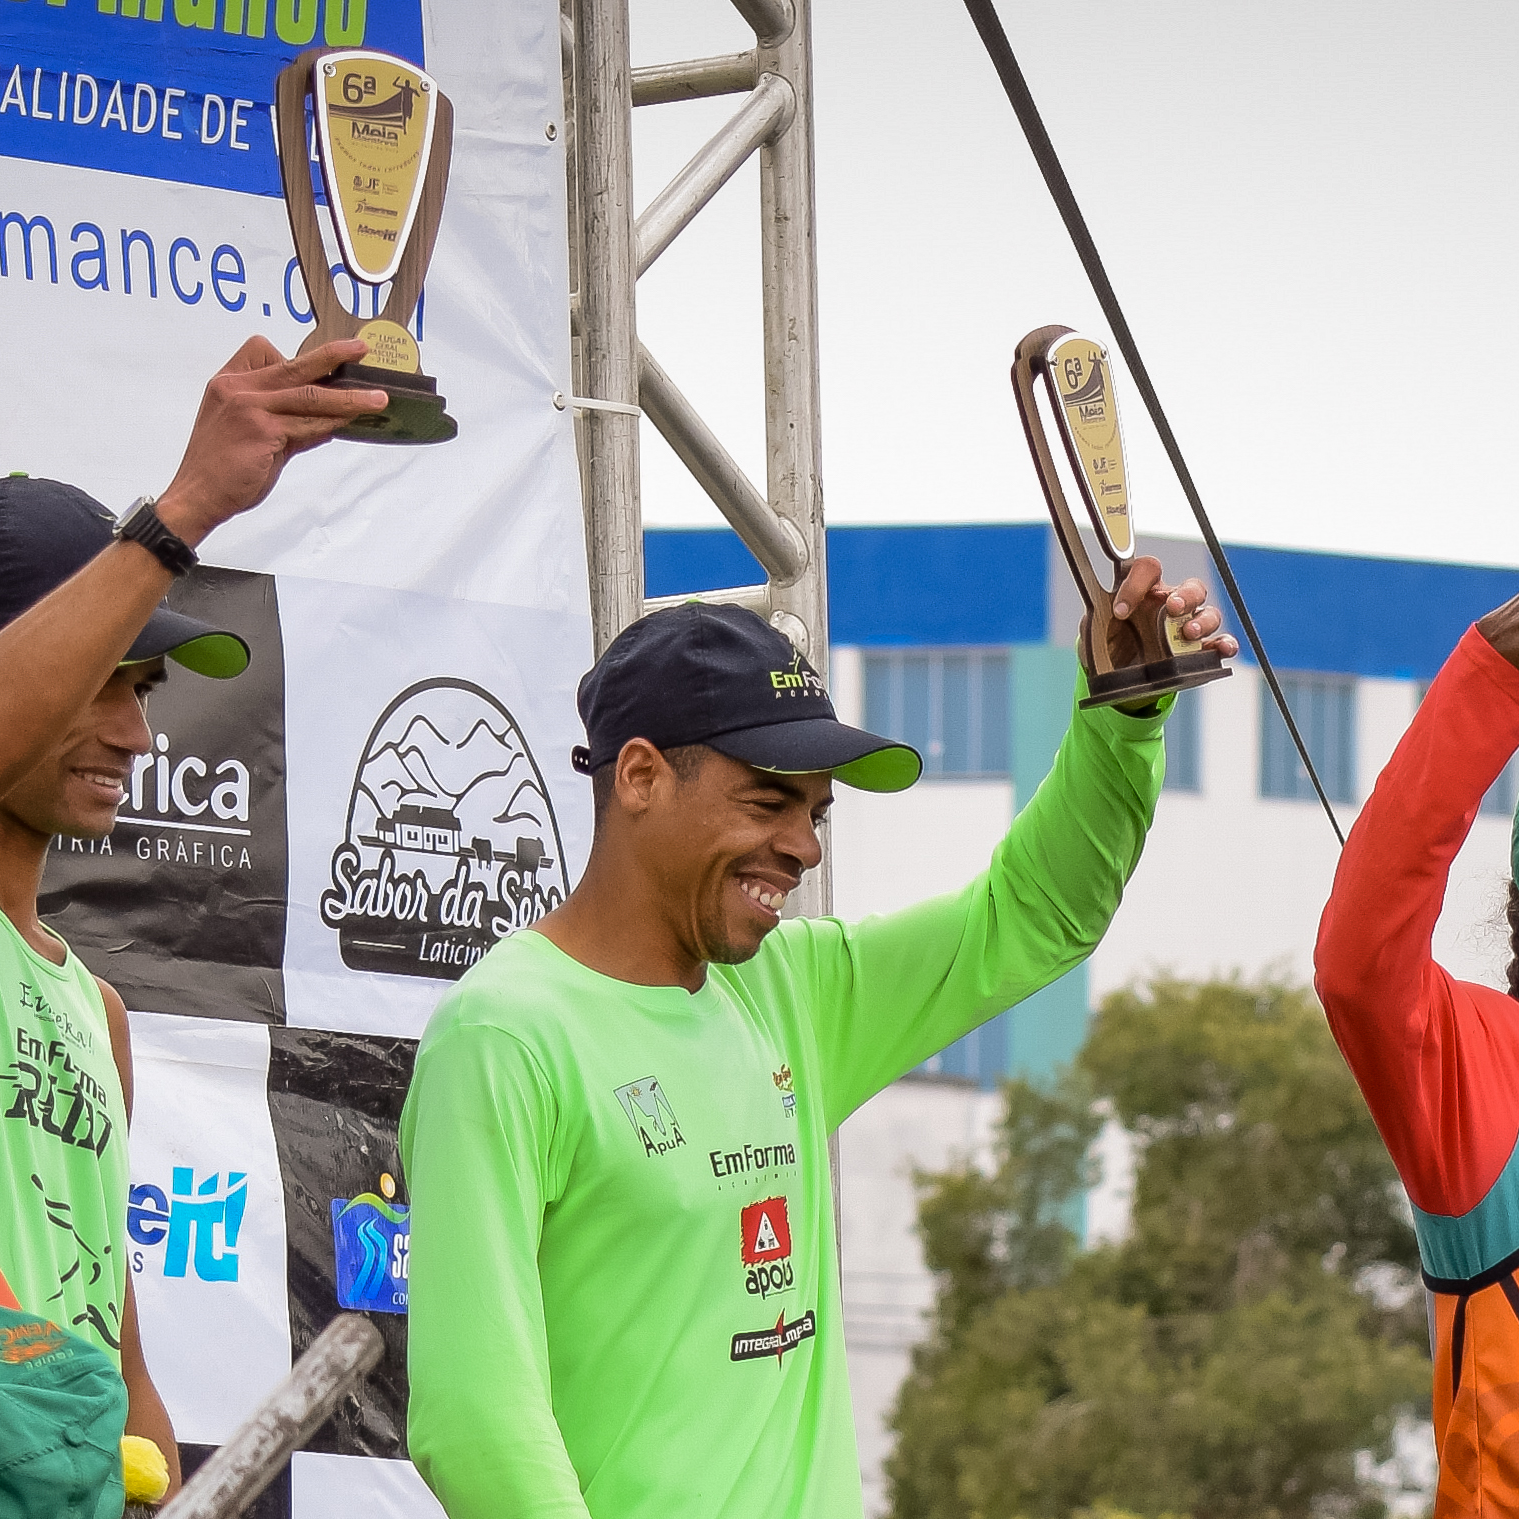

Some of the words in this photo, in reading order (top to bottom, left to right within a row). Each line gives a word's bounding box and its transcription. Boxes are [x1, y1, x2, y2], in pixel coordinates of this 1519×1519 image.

[343, 73, 376, 103] 6ª
[200, 94, 250, 150] DE
[119, 733, 250, 821] rica
[136, 835, 252, 870] GRÁFICA
[325, 851, 428, 922] Sabor
[440, 864, 483, 928] da
[709, 1142, 796, 1178] EmForma
